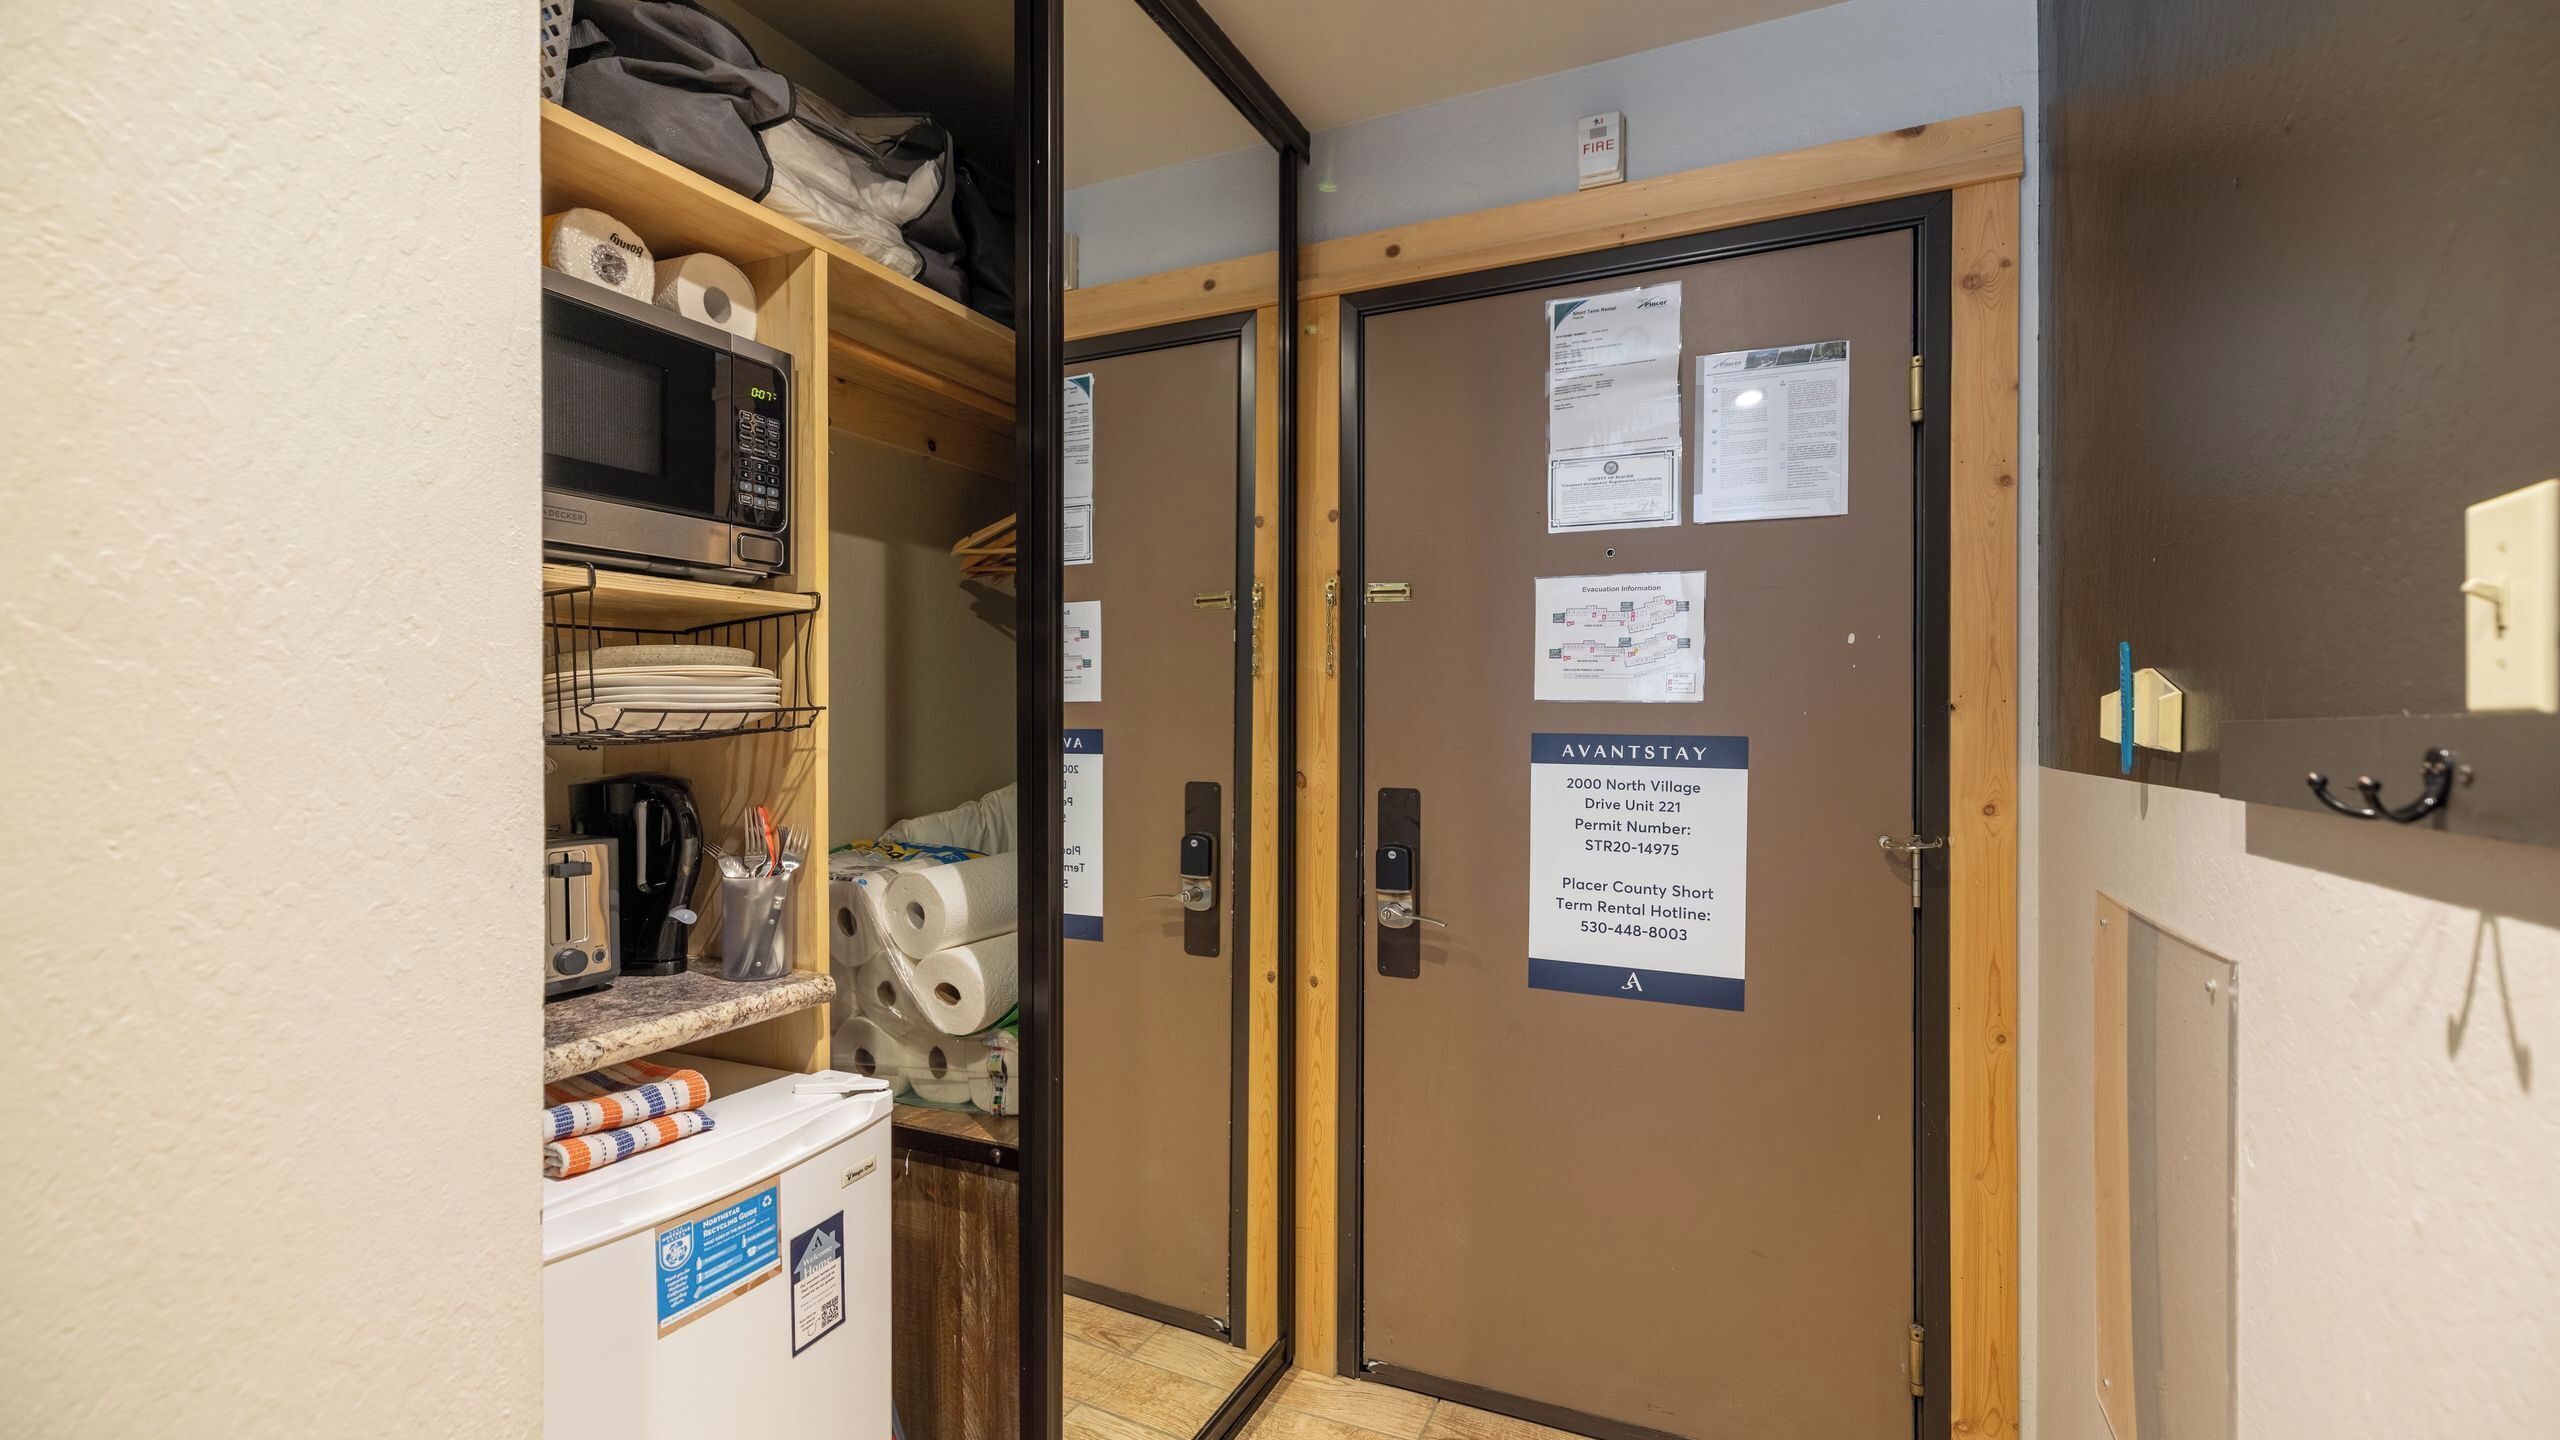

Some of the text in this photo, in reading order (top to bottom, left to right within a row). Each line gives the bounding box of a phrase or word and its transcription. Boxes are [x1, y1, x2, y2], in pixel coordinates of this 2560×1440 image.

[1583, 139, 1615, 155] FIRE
[1644, 300, 1668, 308] Placer
[1562, 744, 1708, 761] AVANTSTAY
[1566, 778, 1701, 796] 2000 North Village
[1585, 798, 1681, 812] Drive Unit 221
[1575, 818, 1692, 836] Permit Number:
[1585, 840, 1680, 856] STR20-14975
[1562, 878, 1714, 900] Placer County Short
[1556, 898, 1711, 922] Term Rental Hotline:
[1580, 921, 1688, 940] 530-448-8003
[852, 1169, 864, 1178] Magic
[703, 1207, 740, 1228] NORTHSTAR
[703, 1217, 738, 1238] RECYCLING
[739, 1207, 758, 1220] GUIDE
[803, 1246, 832, 1266] Welcome
[804, 1256, 832, 1278] Home
